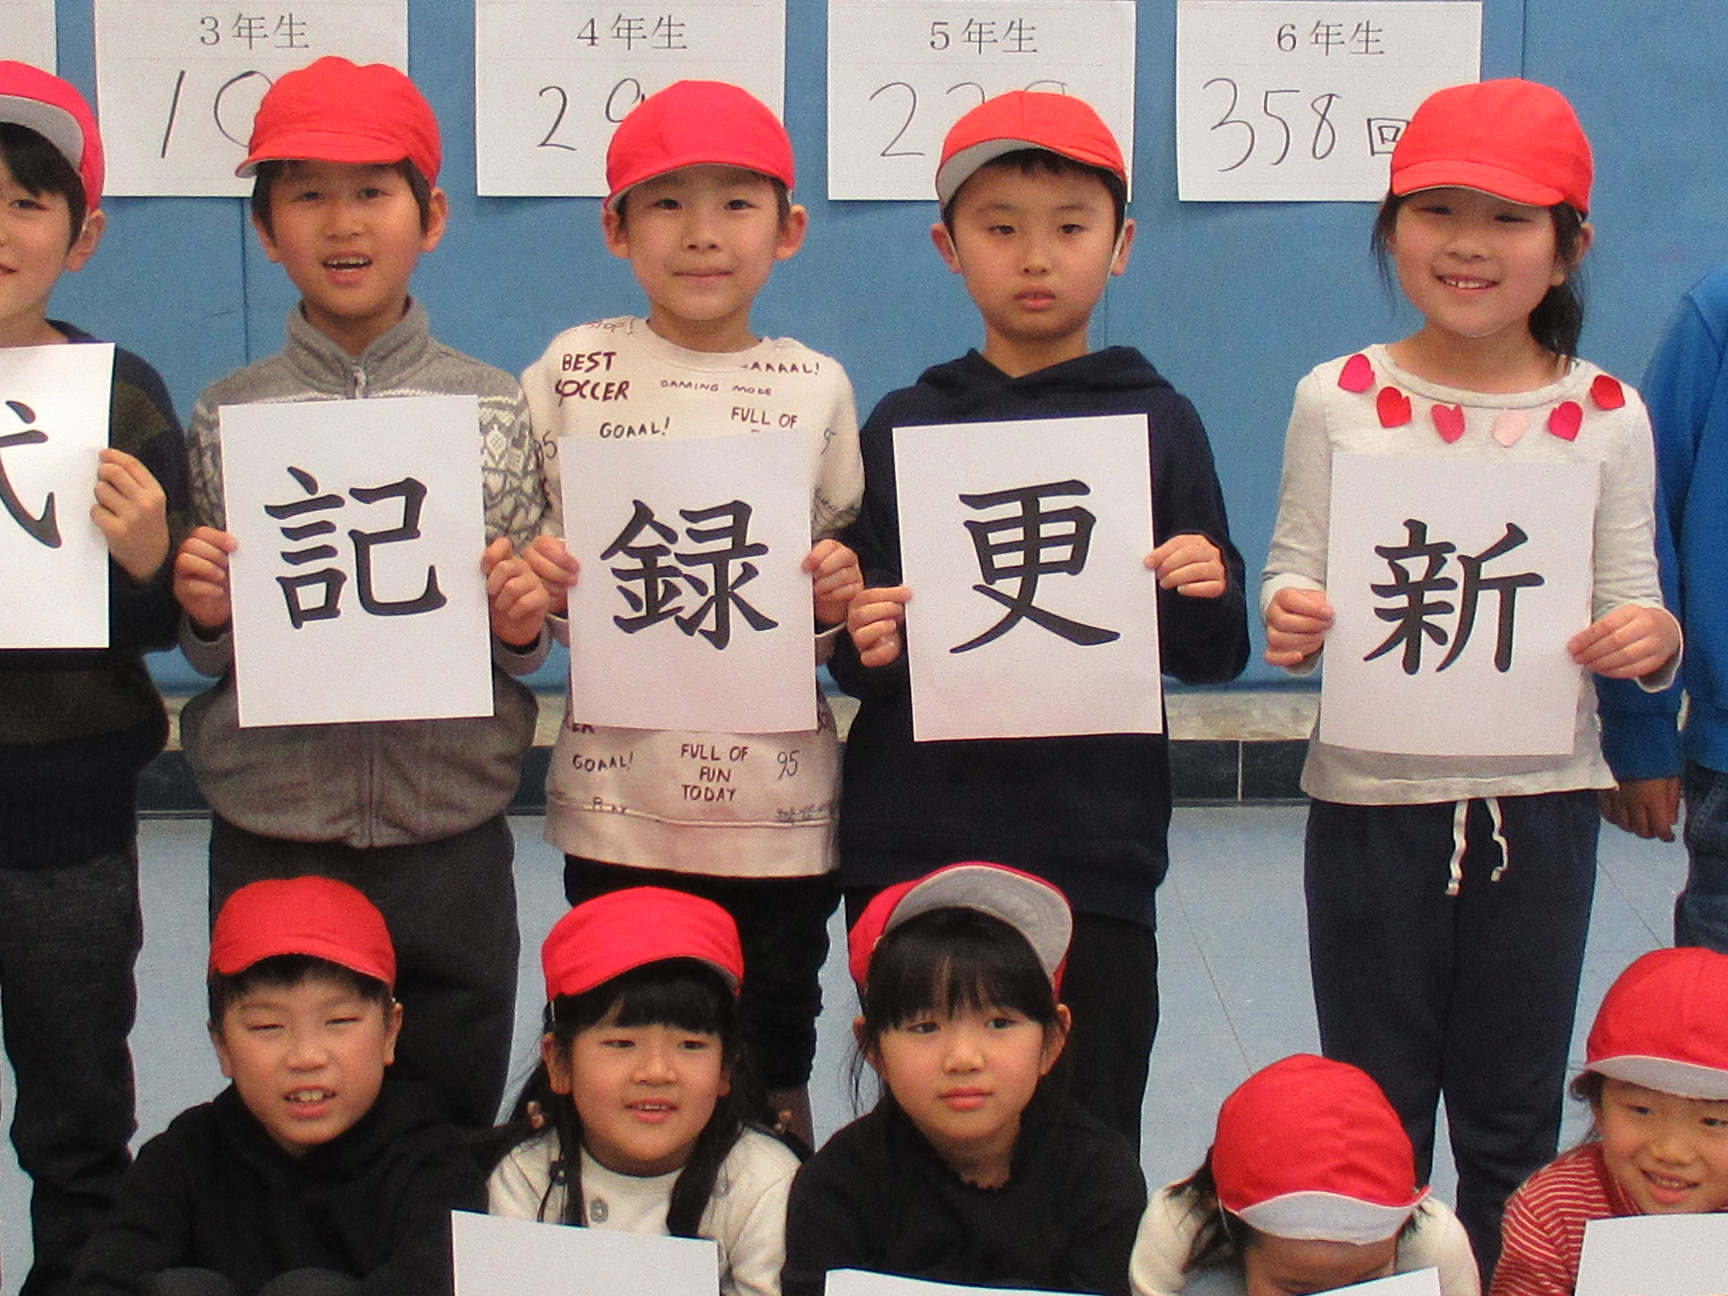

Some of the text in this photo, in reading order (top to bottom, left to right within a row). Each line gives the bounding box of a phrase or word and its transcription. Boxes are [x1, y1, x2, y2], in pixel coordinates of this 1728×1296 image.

[198, 11, 311, 51] 3年生
[576, 13, 689, 52] 4年生
[928, 17, 1039, 56] 5年生
[1275, 19, 1386, 57] 6年生
[562, 350, 618, 374] BEST
[731, 406, 799, 429] FULL OF
[262, 464, 449, 632] 記
[950, 478, 1122, 655] 更
[599, 499, 780, 651] 録
[1362, 518, 1544, 676] 新
[680, 744, 750, 762] FULL OF
[776, 750, 800, 781] 95
[681, 784, 737, 802] TODAY
[699, 766, 732, 783] FUN
